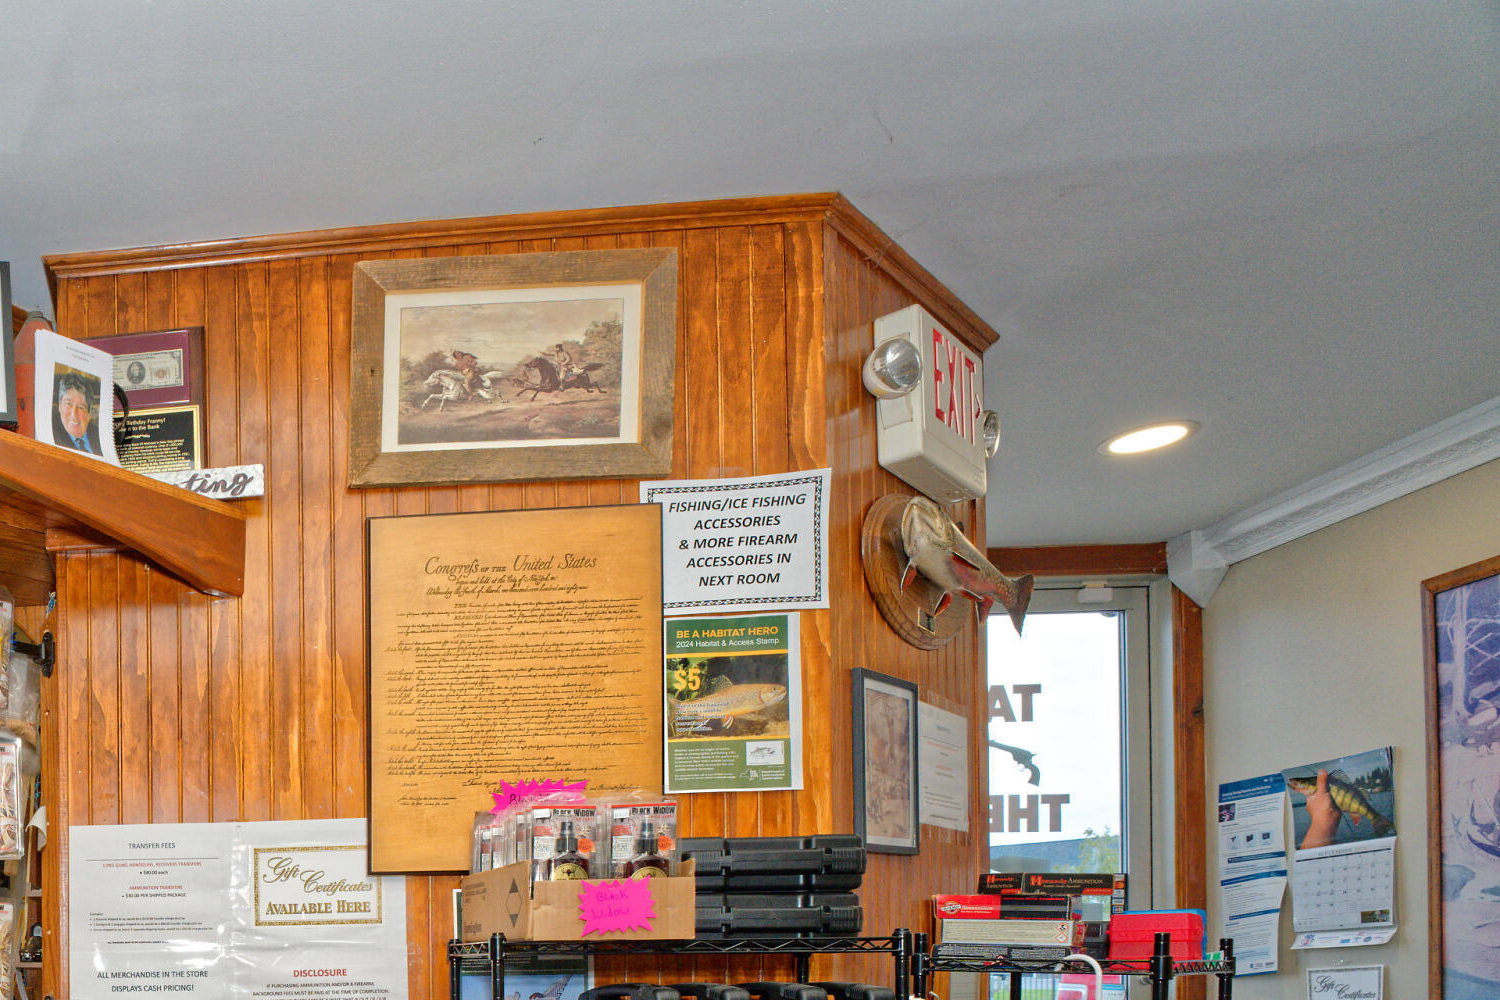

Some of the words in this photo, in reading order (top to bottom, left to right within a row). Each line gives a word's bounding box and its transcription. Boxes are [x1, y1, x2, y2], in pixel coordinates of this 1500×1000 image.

[933, 328, 977, 446] EXIT
[669, 498, 748, 512] FISHING/ICE
[752, 494, 806, 507] FISHING
[694, 516, 780, 530] ACCESSORIES
[679, 540, 689, 550] &
[693, 537, 734, 549] MORE
[738, 534, 797, 546] FIREARM
[513, 555, 552, 571] United
[558, 553, 596, 569] States
[687, 554, 772, 568] ACCESSORIES
[777, 553, 791, 563] IN
[699, 575, 733, 587] NEXT
[737, 573, 780, 585] ROOM
[676, 630, 690, 638] BE
[692, 630, 699, 638] A
[702, 628, 745, 638] HABITAT
[748, 626, 779, 636] HERO
[676, 640, 693, 648] 2024
[695, 639, 719, 647] Habitat
[729, 638, 754, 646] Access
[756, 638, 779, 647] Stamp
[673, 668, 701, 691] $5
[263, 857, 300, 883] Gift
[300, 870, 373, 896] Certificates
[266, 901, 332, 915] AVAILABLE
[337, 900, 371, 913] HERE
[293, 968, 348, 978] DISCLOSURE
